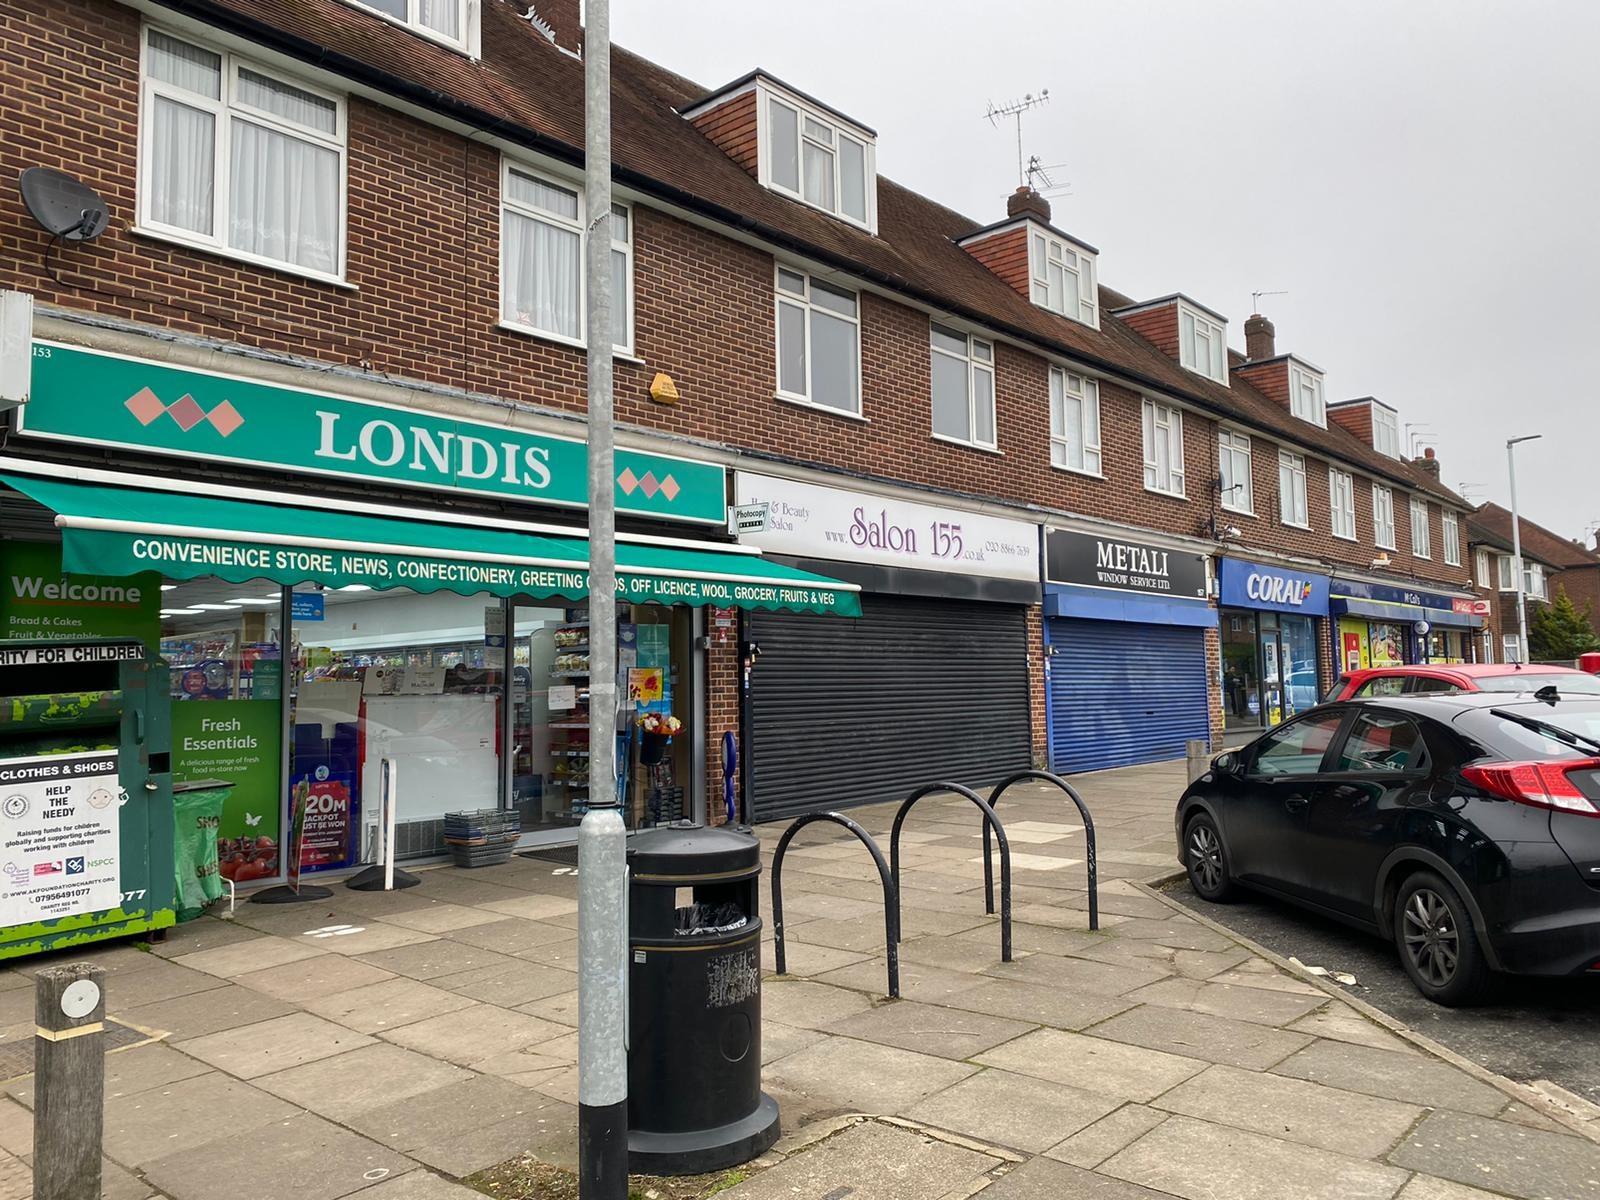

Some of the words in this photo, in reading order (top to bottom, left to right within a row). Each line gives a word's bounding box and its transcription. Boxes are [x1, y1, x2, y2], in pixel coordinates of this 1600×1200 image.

[33, 346, 52, 359] 153
[314, 410, 551, 489] LONDIS
[736, 509, 766, 519] Photocopy
[782, 502, 809, 522] Beauty
[769, 517, 793, 531] Salon
[849, 506, 918, 554] Salon
[132, 539, 271, 568] CONVENIENCE
[275, 551, 338, 575] STORE,
[341, 556, 393, 579] NEWS,
[397, 560, 518, 588] CONFECTIONERY,
[520, 570, 584, 589] GREETING
[1096, 541, 1169, 576] METALI
[1096, 571, 1128, 585] WINDOW
[1130, 575, 1157, 589] SERVICE
[11, 575, 141, 602] Welcome
[630, 578, 652, 593] OFF
[654, 580, 700, 598] LICENCE,
[701, 584, 733, 601] WOOL,
[734, 586, 779, 603] GROCERY,
[779, 588, 809, 603] FRUITS
[810, 593, 818, 604] &
[818, 593, 835, 605] VEG
[1247, 573, 1303, 605] CORAL
[9, 616, 40, 625] Bread
[42, 617, 51, 625] &
[53, 617, 82, 626] Cakes
[9, 630, 33, 639] Fruit
[35, 631, 45, 639] &
[36, 648, 66, 663] FOR
[72, 645, 145, 662] CHILDREN
[202, 717, 241, 732] Fresh
[183, 735, 257, 751] Essentials
[216, 758, 235, 766] range
[0, 766, 59, 780] CLOTHES
[62, 765, 71, 775] &
[74, 761, 114, 774] SHOES
[45, 785, 72, 796] HELP
[49, 797, 68, 807] THE
[42, 807, 75, 819] NEEDY
[17, 828, 42, 837] Raising
[43, 825, 62, 833] funds
[63, 824, 73, 832] for
[74, 822, 100, 831] children
[327, 820, 346, 828] WON
[5, 837, 32, 848] globally
[33, 835, 46, 843] and
[47, 832, 82, 843] supporting
[83, 828, 111, 837] charities
[23, 843, 51, 853] working
[53, 841, 67, 849] with
[68, 838, 94, 847] children
[87, 857, 114, 868] NSPCC
[35, 888, 91, 903] 07956491077
[40, 902, 61, 911] CHARITY
